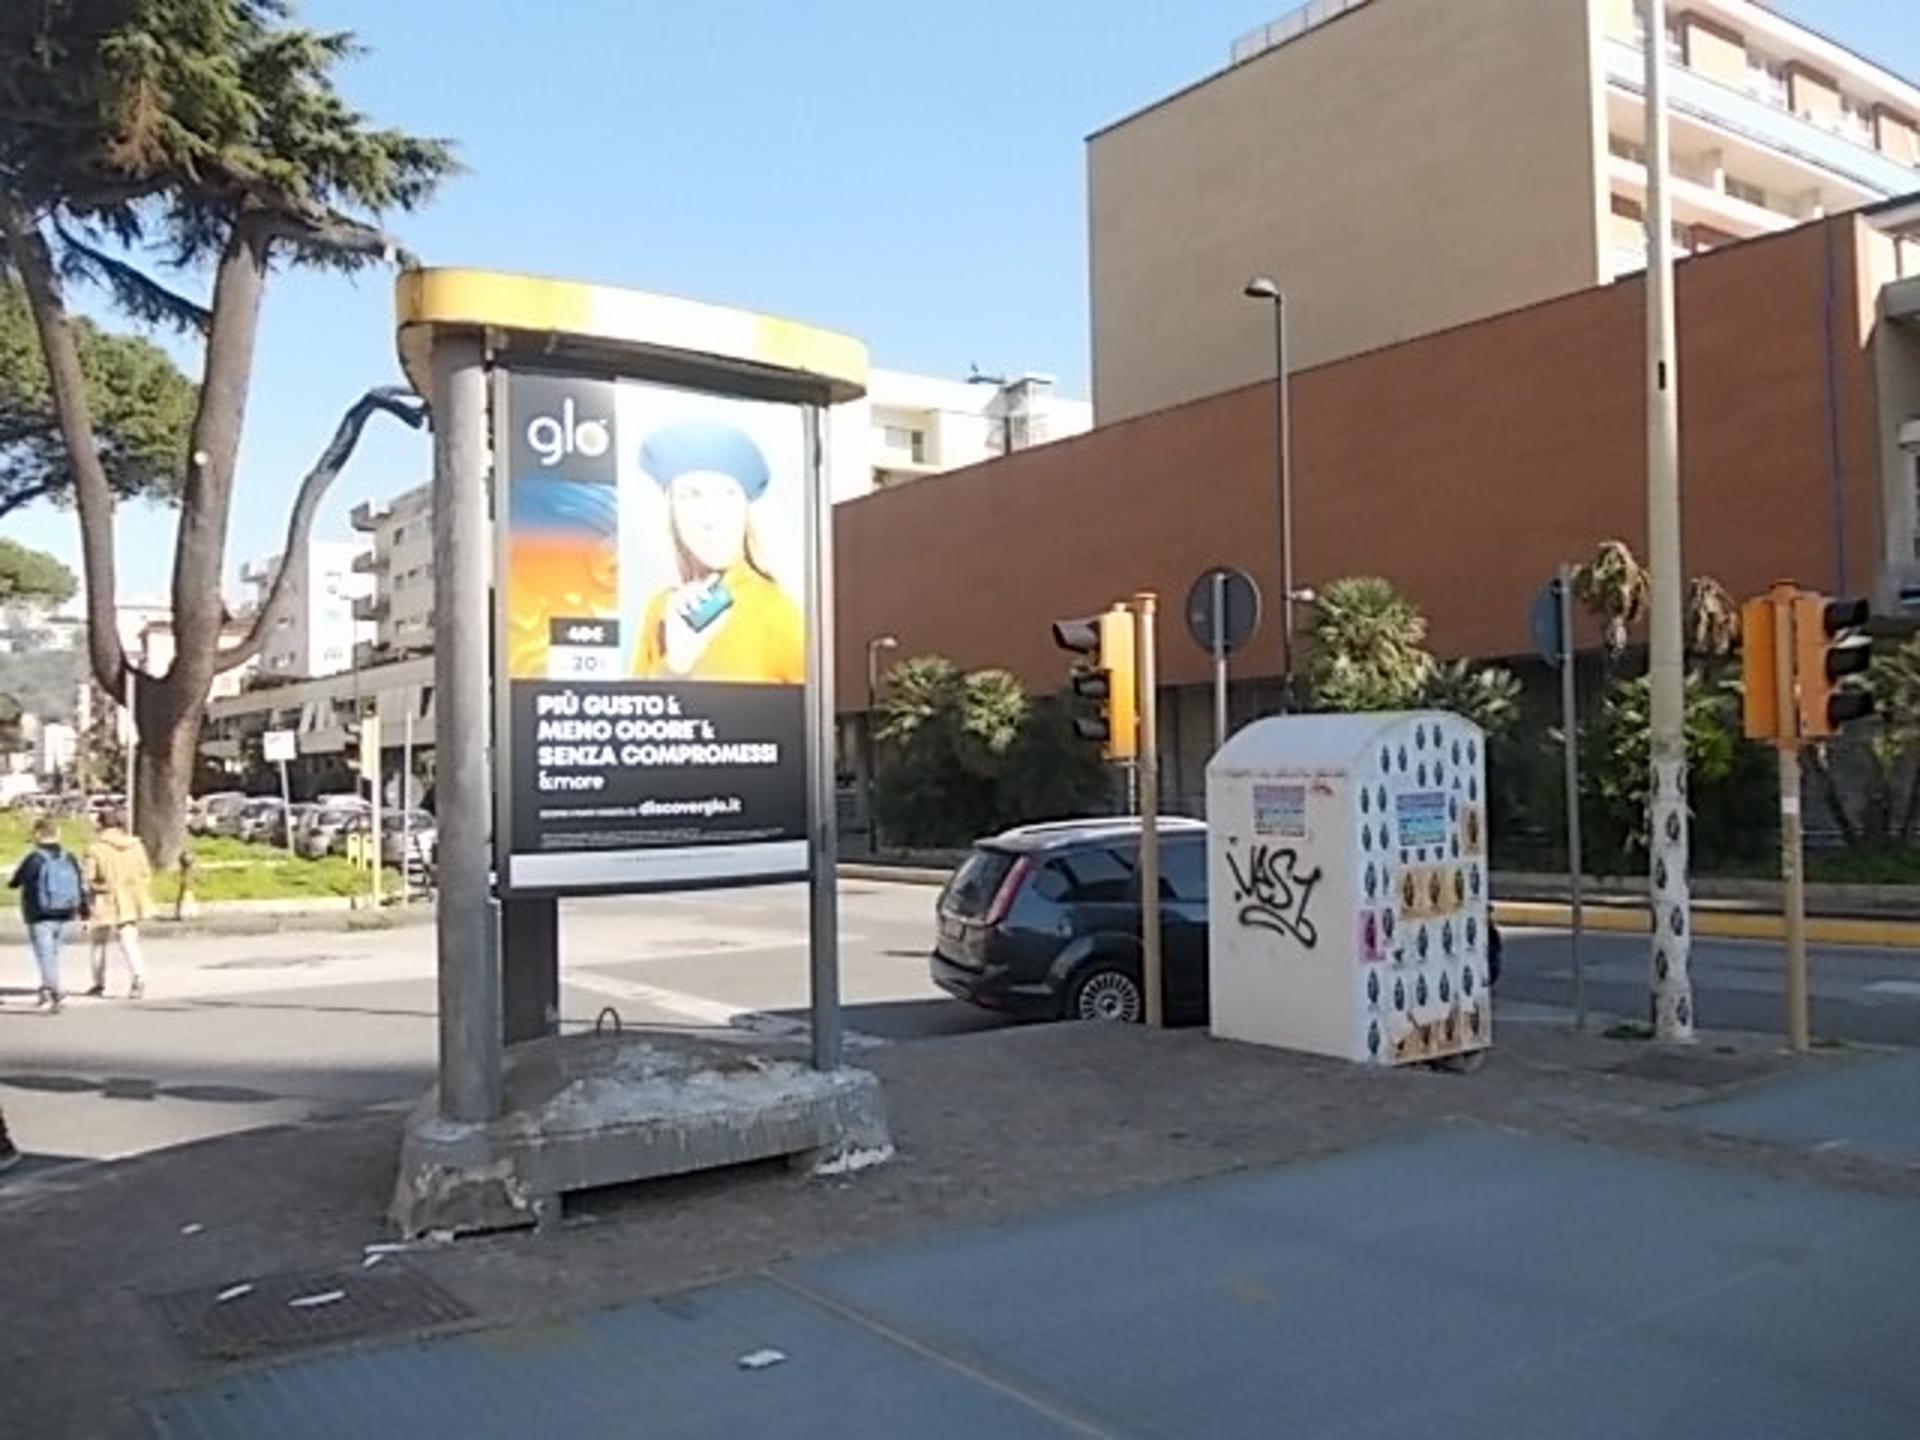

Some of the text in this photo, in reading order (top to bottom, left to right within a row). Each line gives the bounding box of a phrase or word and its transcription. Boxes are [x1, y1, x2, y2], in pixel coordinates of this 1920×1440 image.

[527, 397, 609, 466] glo
[536, 690, 579, 715] PIÙ
[583, 695, 664, 717] GUSTO
[537, 720, 612, 741] MENO
[538, 743, 779, 767] SENZA COMPROMESSI
[638, 797, 742, 818] discoverglo.it
